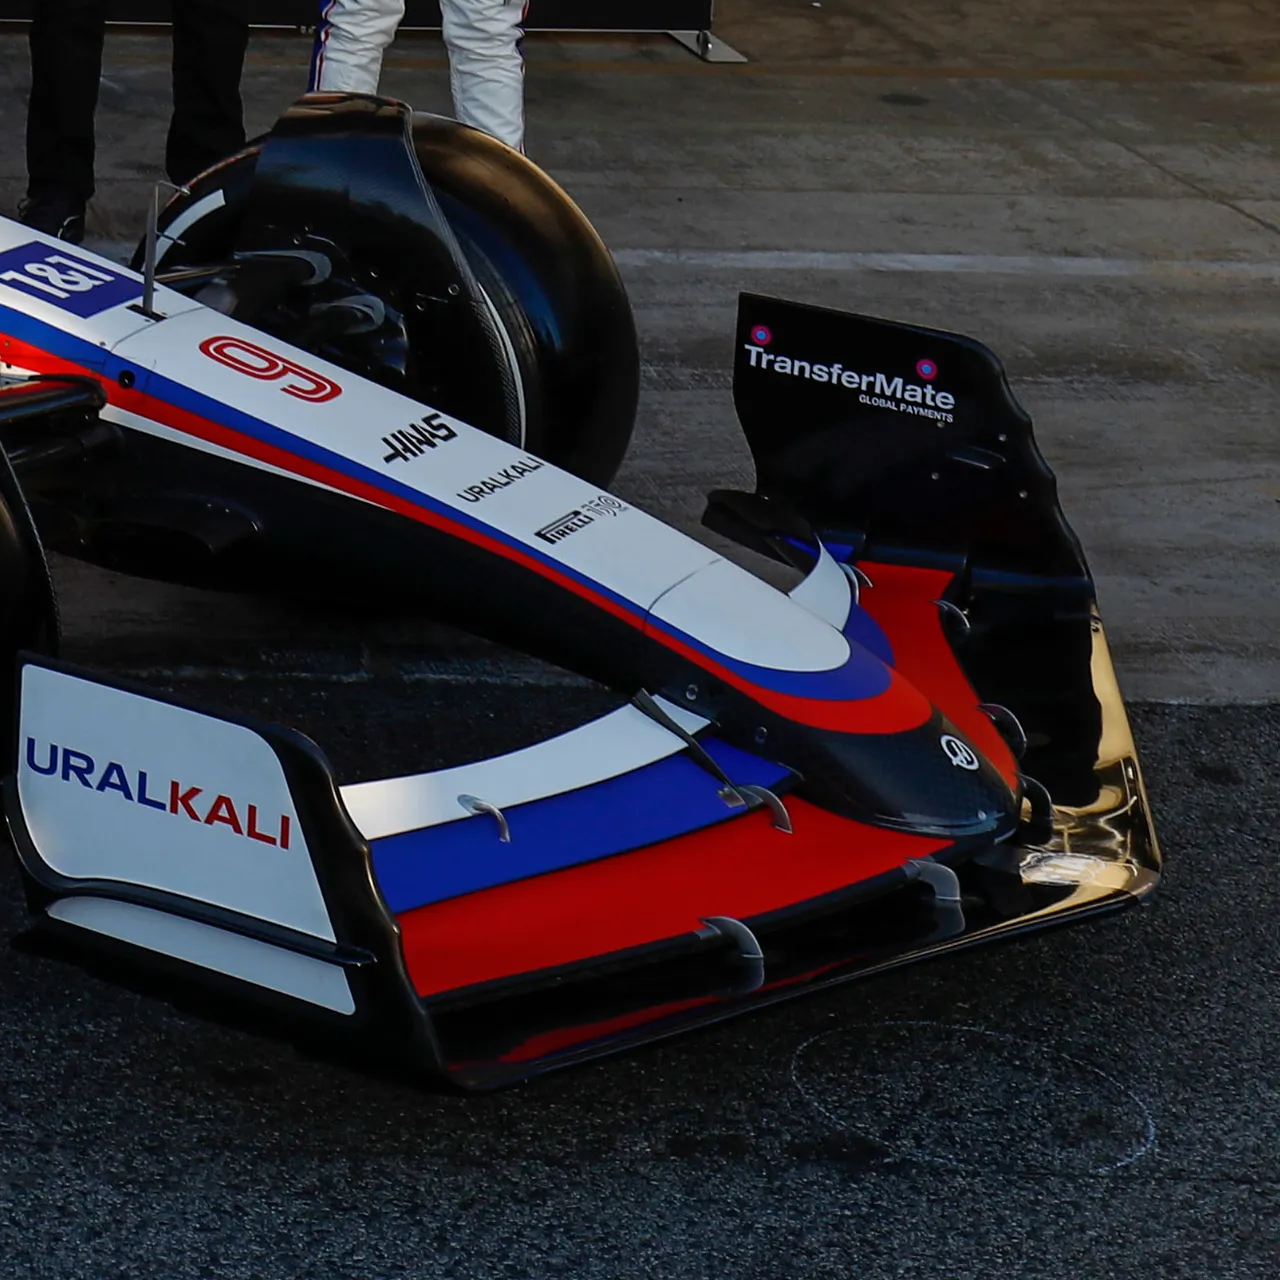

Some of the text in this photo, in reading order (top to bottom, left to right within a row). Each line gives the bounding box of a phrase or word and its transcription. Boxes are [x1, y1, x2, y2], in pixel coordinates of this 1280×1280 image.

[198, 335, 343, 403] 9
[744, 344, 956, 410] TransferMate
[858, 394, 954, 424] GLOBAL PAYMENTS
[382, 412, 458, 465] HAAS
[456, 456, 545, 504] URALKALI
[534, 510, 595, 545] PIRELLI
[26, 736, 291, 851] URALKALI
